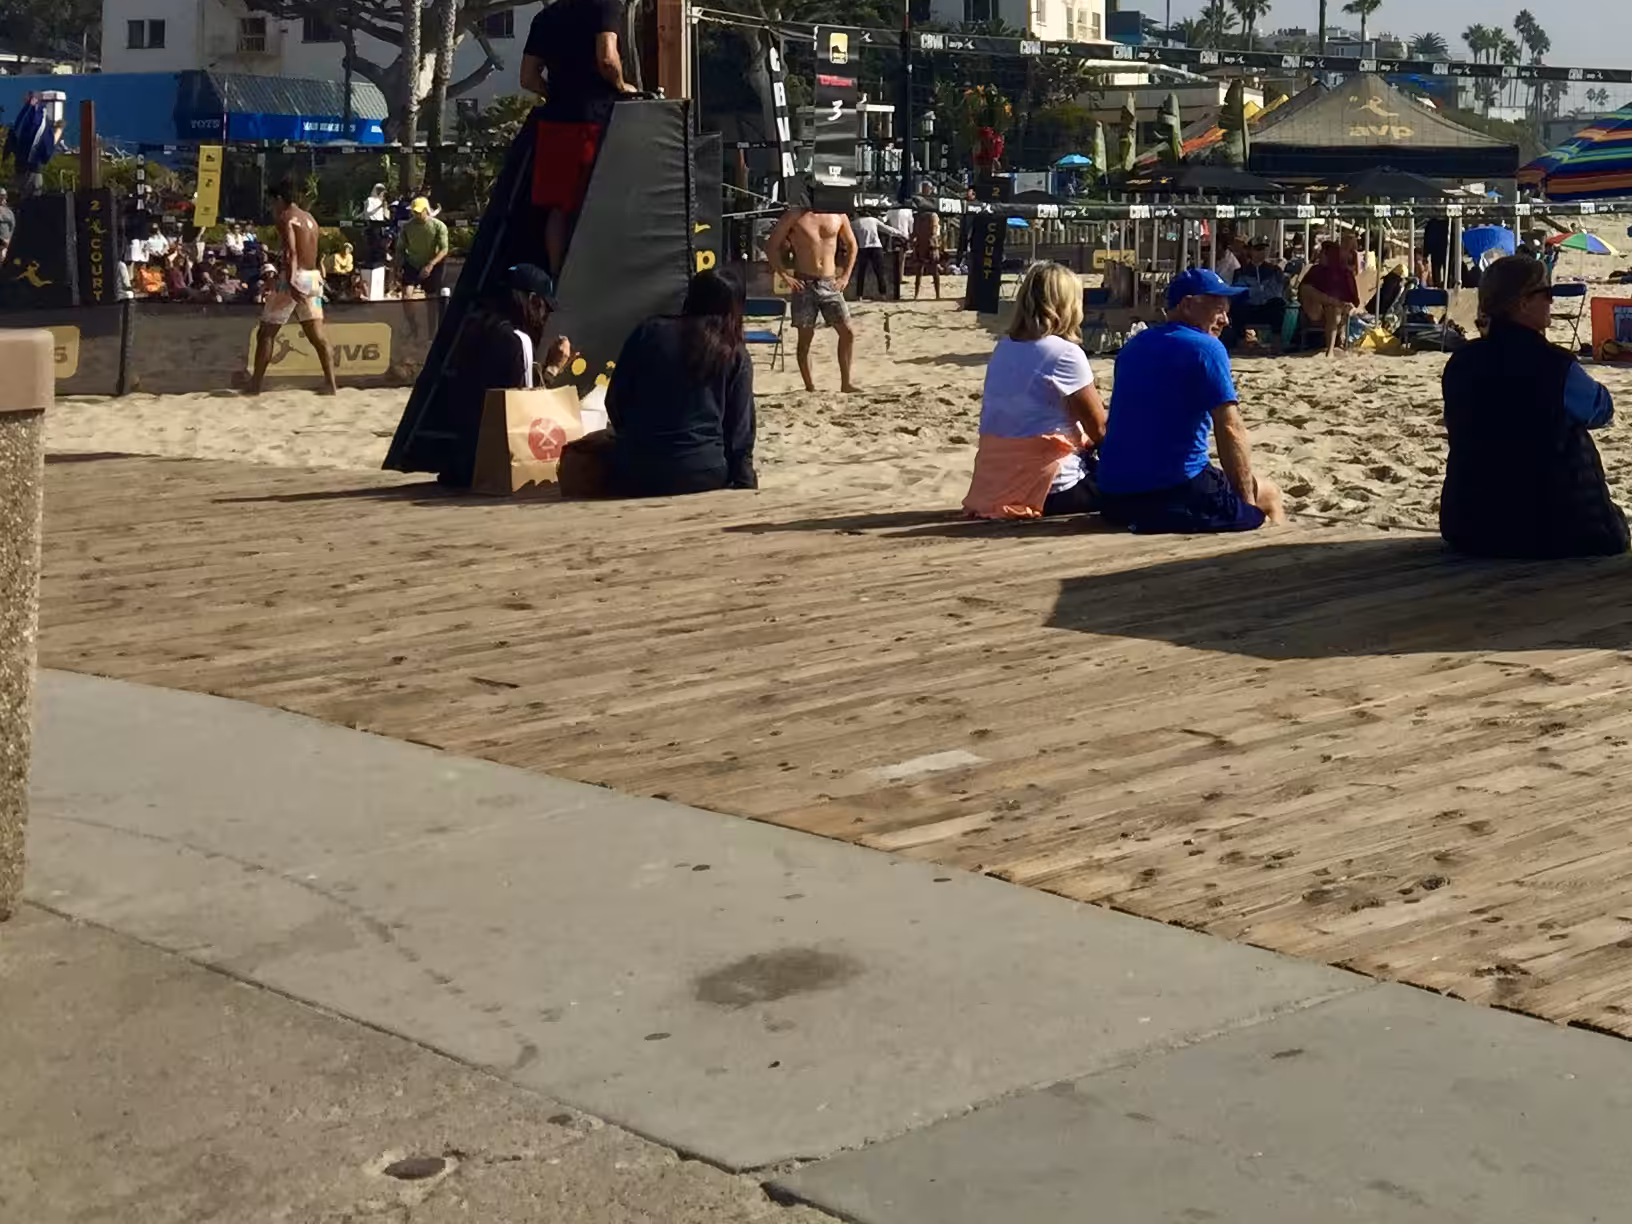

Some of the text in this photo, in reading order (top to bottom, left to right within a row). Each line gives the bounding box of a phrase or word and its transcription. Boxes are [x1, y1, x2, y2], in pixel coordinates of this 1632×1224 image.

[920, 34, 943, 49] CBVA
[769, 47, 796, 178] CBVA
[827, 100, 843, 121] 3
[1348, 125, 1415, 140] avp
[136, 154, 145, 210] CBVA
[991, 187, 1001, 197] 2
[90, 200, 101, 210] 2
[939, 199, 982, 214] CBVA avp
[983, 222, 997, 279] COURT
[90, 238, 103, 302] COURT
